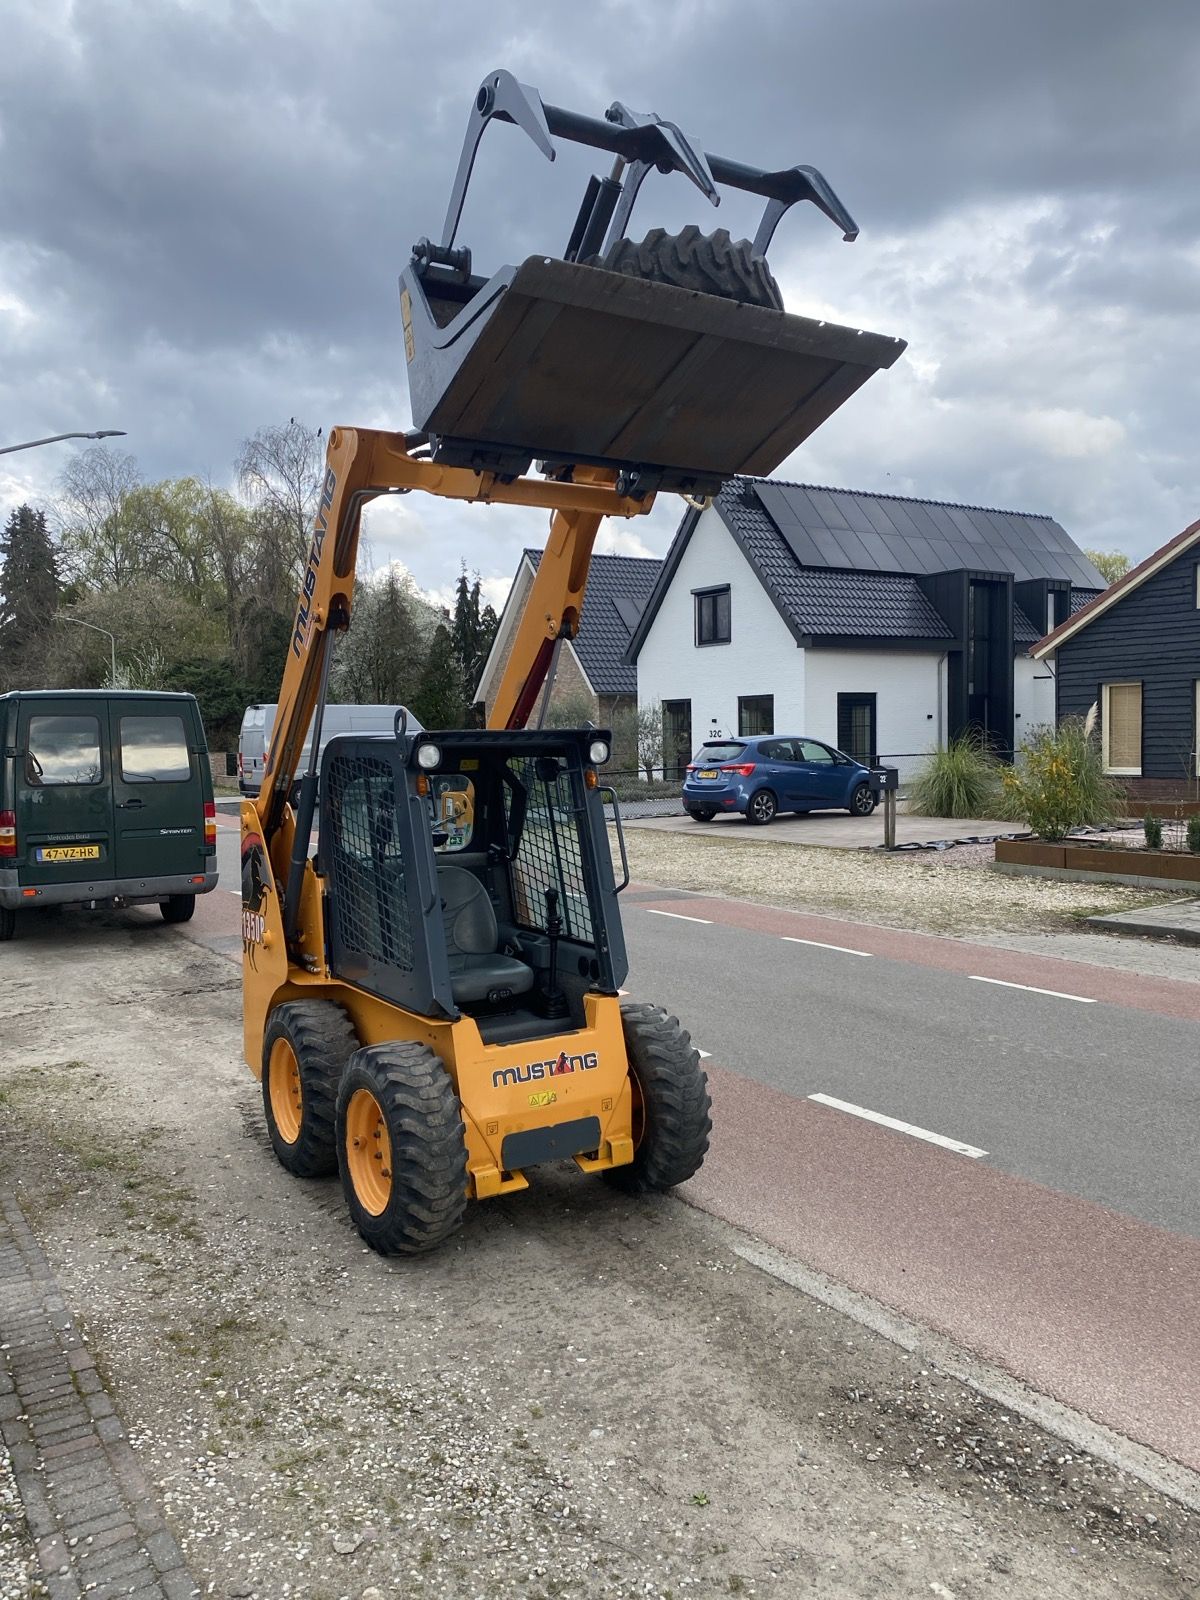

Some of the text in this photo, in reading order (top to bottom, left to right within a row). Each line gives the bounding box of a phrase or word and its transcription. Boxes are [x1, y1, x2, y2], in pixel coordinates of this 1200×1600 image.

[292, 467, 337, 660] MUSTANG
[709, 730, 722, 738] 32C
[45, 848, 94, 860] 47-VZ-HR
[492, 1053, 598, 1088] MUSTANG
